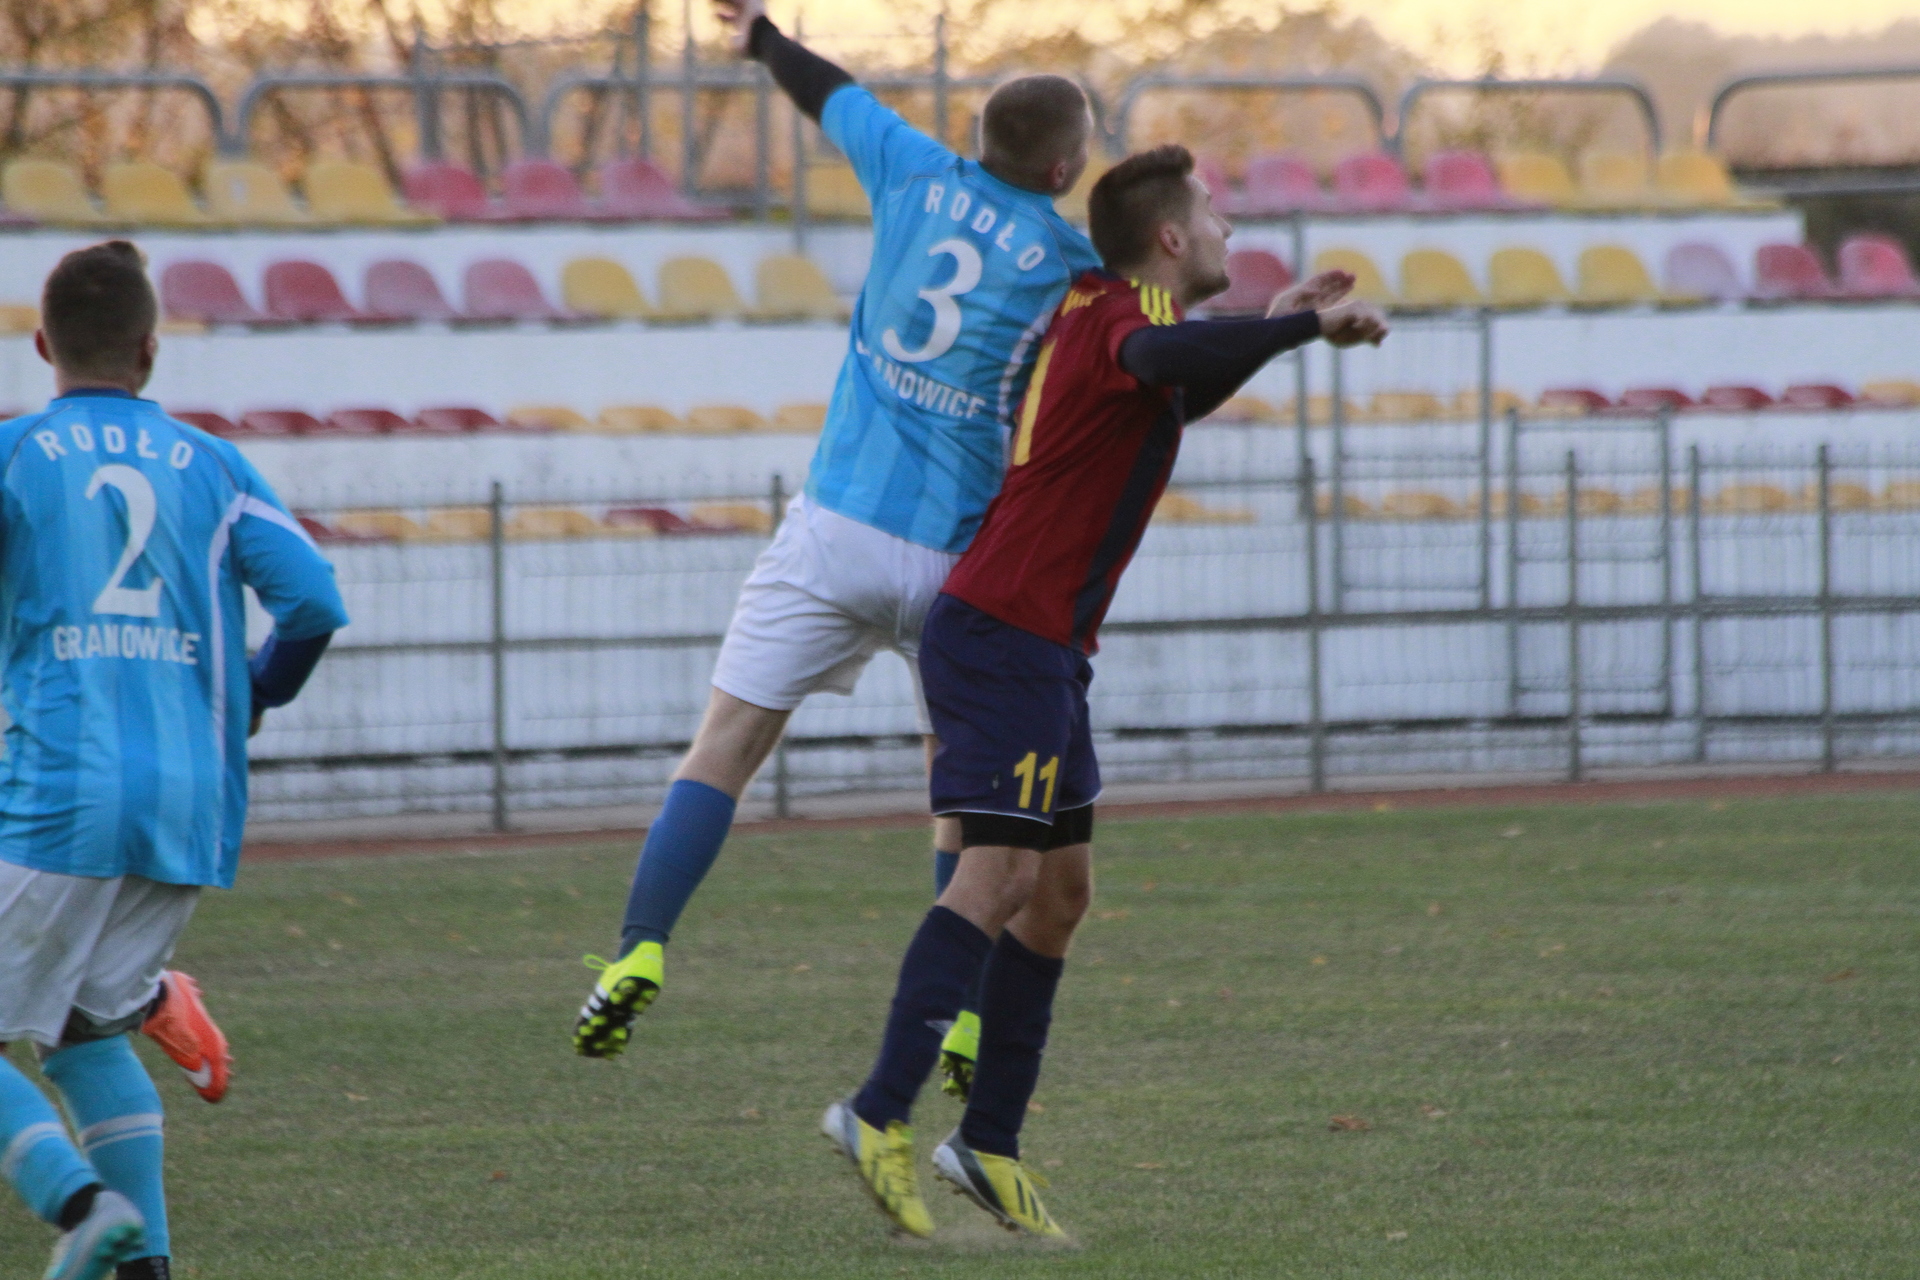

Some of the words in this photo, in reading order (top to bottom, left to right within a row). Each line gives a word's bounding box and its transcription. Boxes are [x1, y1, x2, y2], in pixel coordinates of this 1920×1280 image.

[881, 239, 983, 363] 3
[85, 463, 163, 617] 2
[52, 624, 201, 665] GRANOWICE
[1013, 751, 1059, 813] 11
